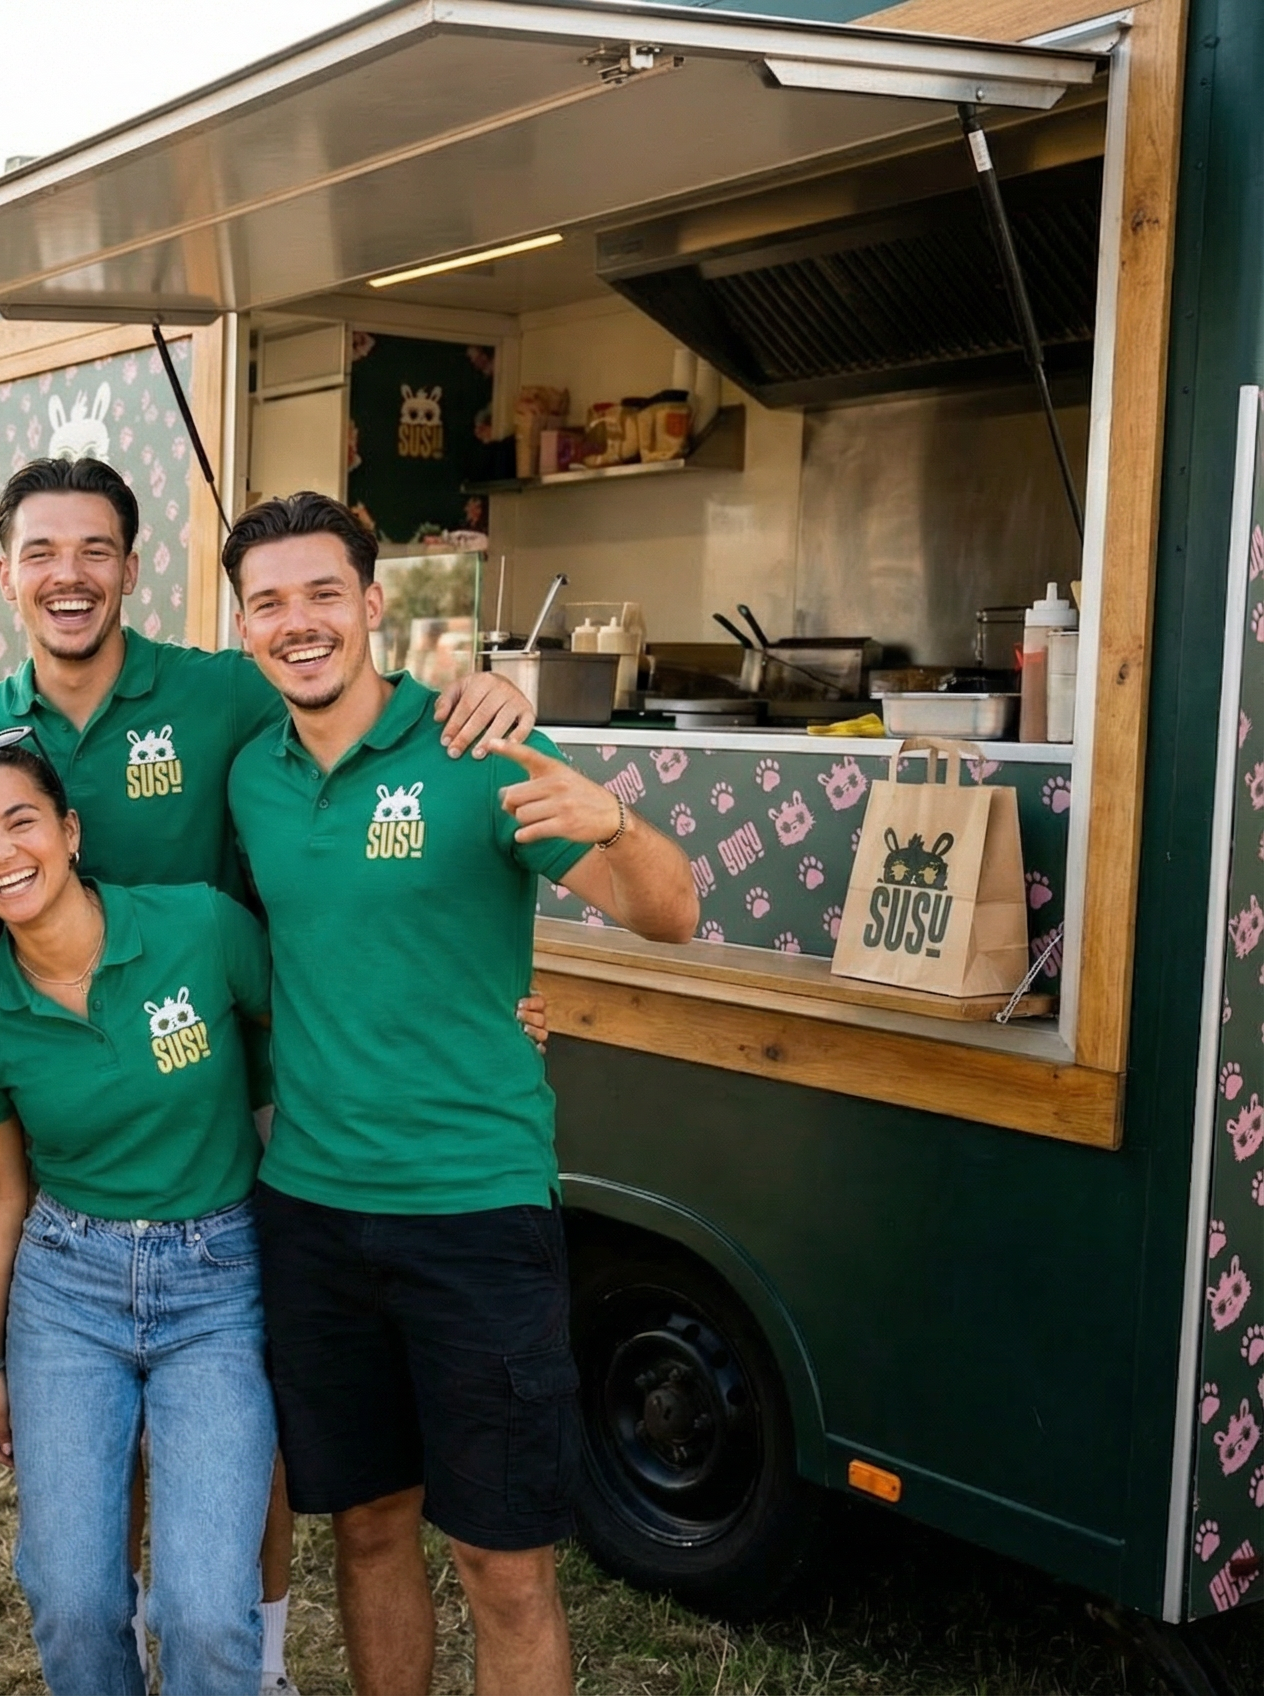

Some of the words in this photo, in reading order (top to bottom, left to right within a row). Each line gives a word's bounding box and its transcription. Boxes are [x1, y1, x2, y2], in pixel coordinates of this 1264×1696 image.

[126, 759, 183, 799] SUSU
[366, 820, 425, 859] SUSU
[863, 885, 953, 959] SUSU
